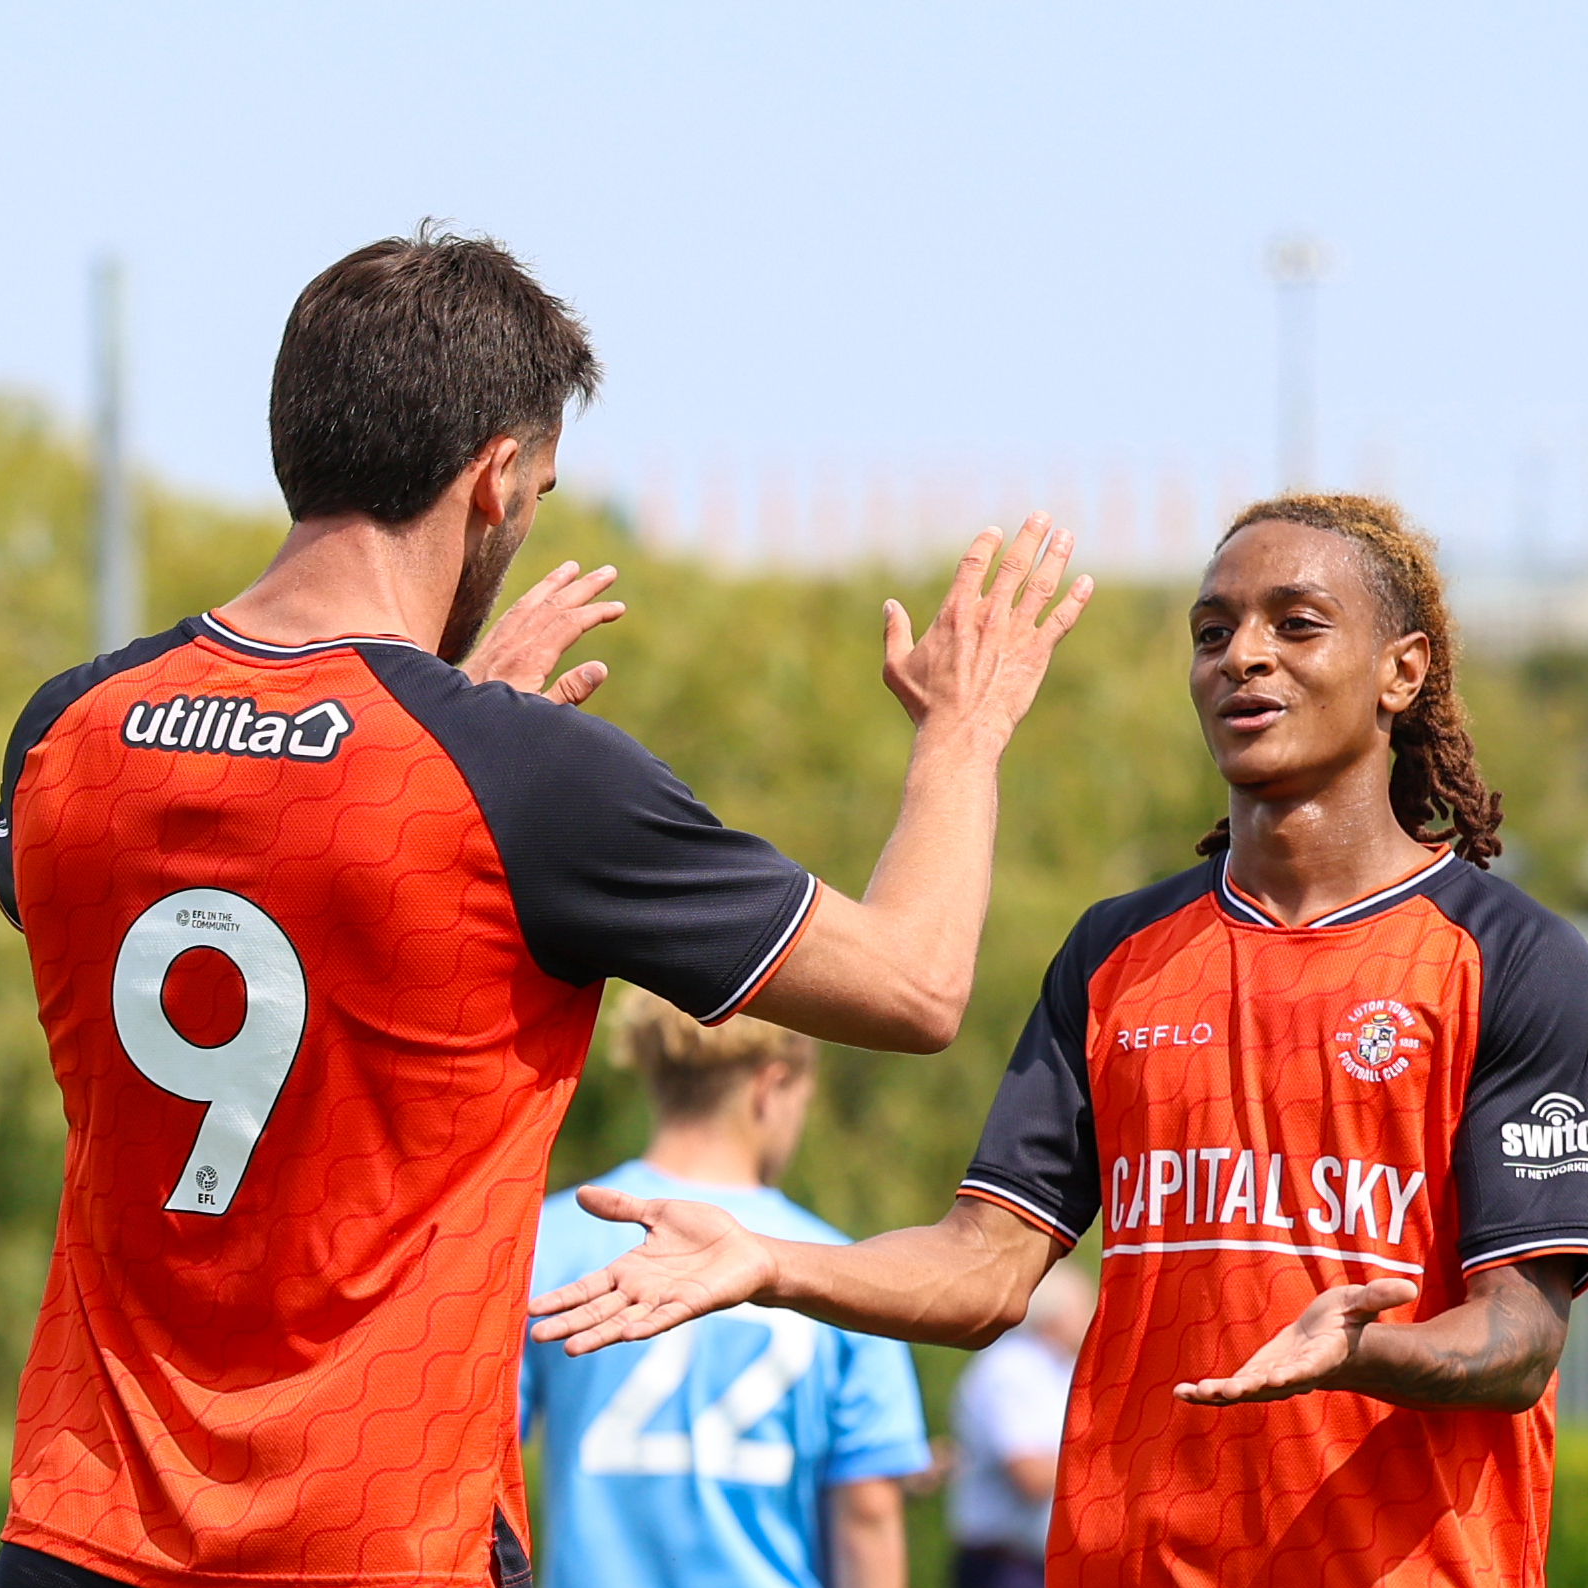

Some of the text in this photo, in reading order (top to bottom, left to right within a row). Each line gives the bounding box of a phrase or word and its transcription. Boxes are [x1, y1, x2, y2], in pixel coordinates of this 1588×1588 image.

[125, 698, 288, 753] utilita
[192, 910, 233, 922] EFL IN THE
[192, 920, 241, 932] COMMUNITY
[1347, 1000, 1416, 1028] LUTON TOWN
[1117, 1022, 1212, 1051] REFLO
[1335, 1032, 1353, 1042] EST
[111, 886, 308, 1217] 9
[1337, 1051, 1410, 1082] FOOTBALL CLUB
[1515, 1168, 1527, 1178] IT
[197, 1193, 216, 1205] EFL
[1110, 1147, 1426, 1245] CAPITAL SKY
[579, 1301, 818, 1488] 22
